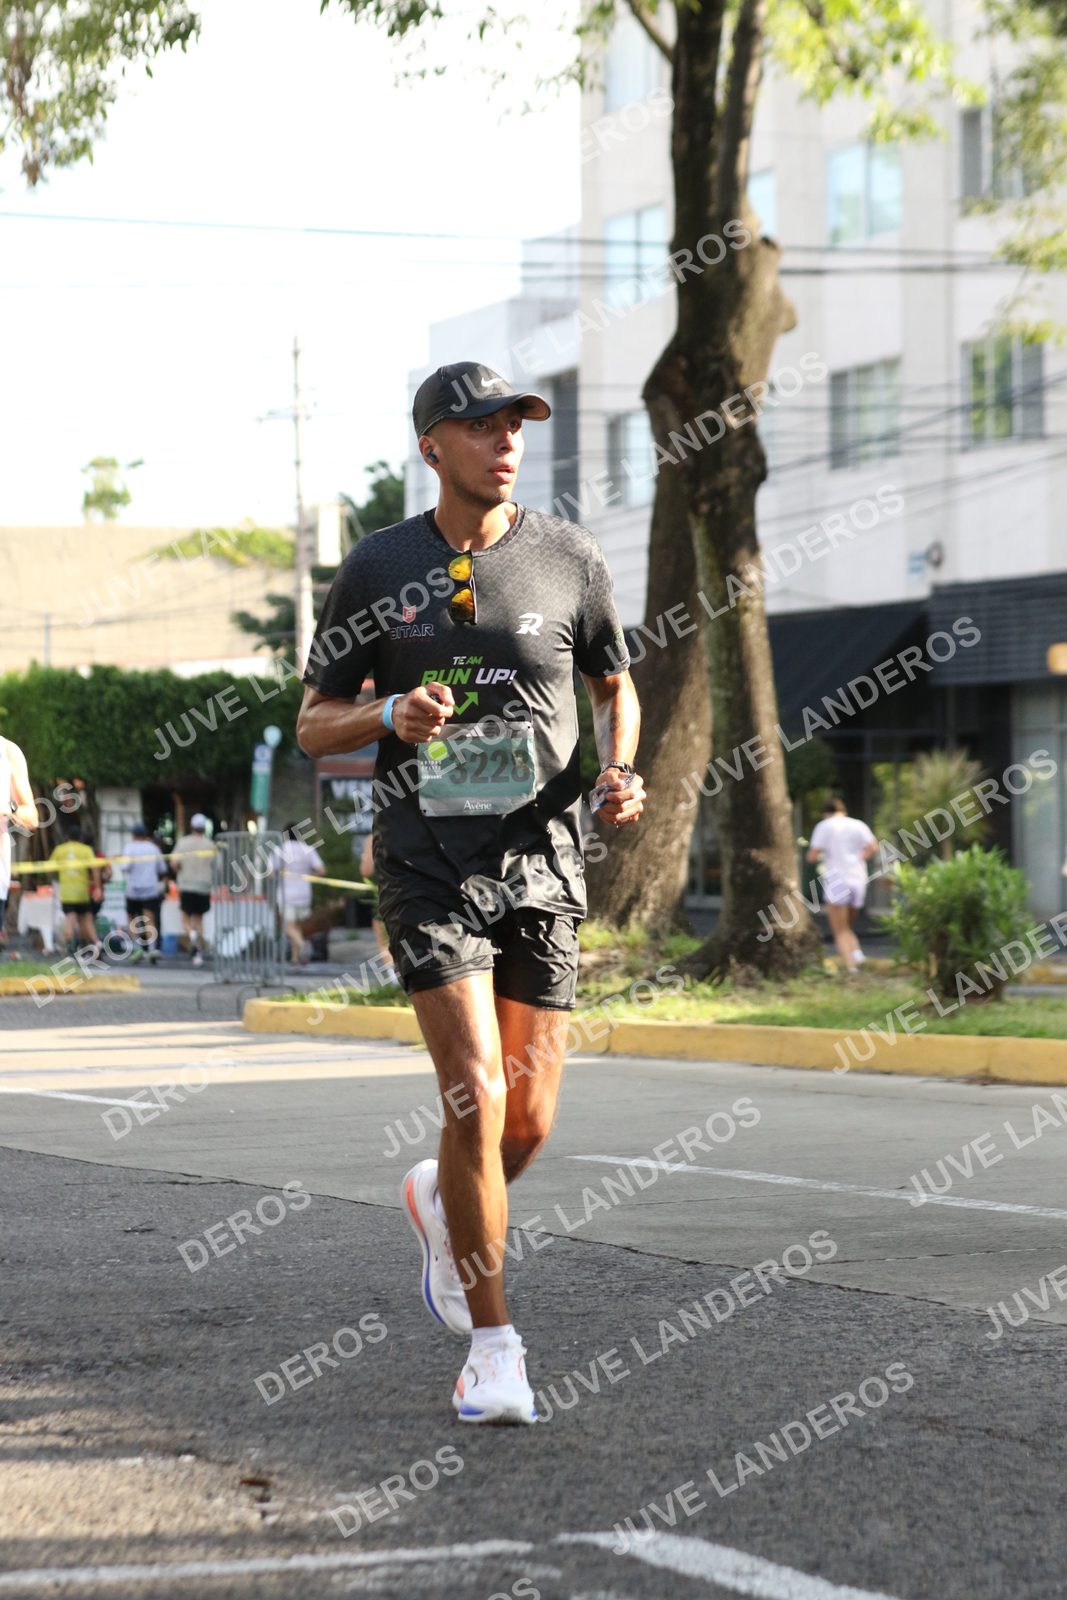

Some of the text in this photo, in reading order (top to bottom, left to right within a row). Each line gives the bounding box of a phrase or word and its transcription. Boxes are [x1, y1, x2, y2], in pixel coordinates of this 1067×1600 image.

[452, 655, 484, 666] TEAM
[420, 667, 518, 686] RUN UP!
